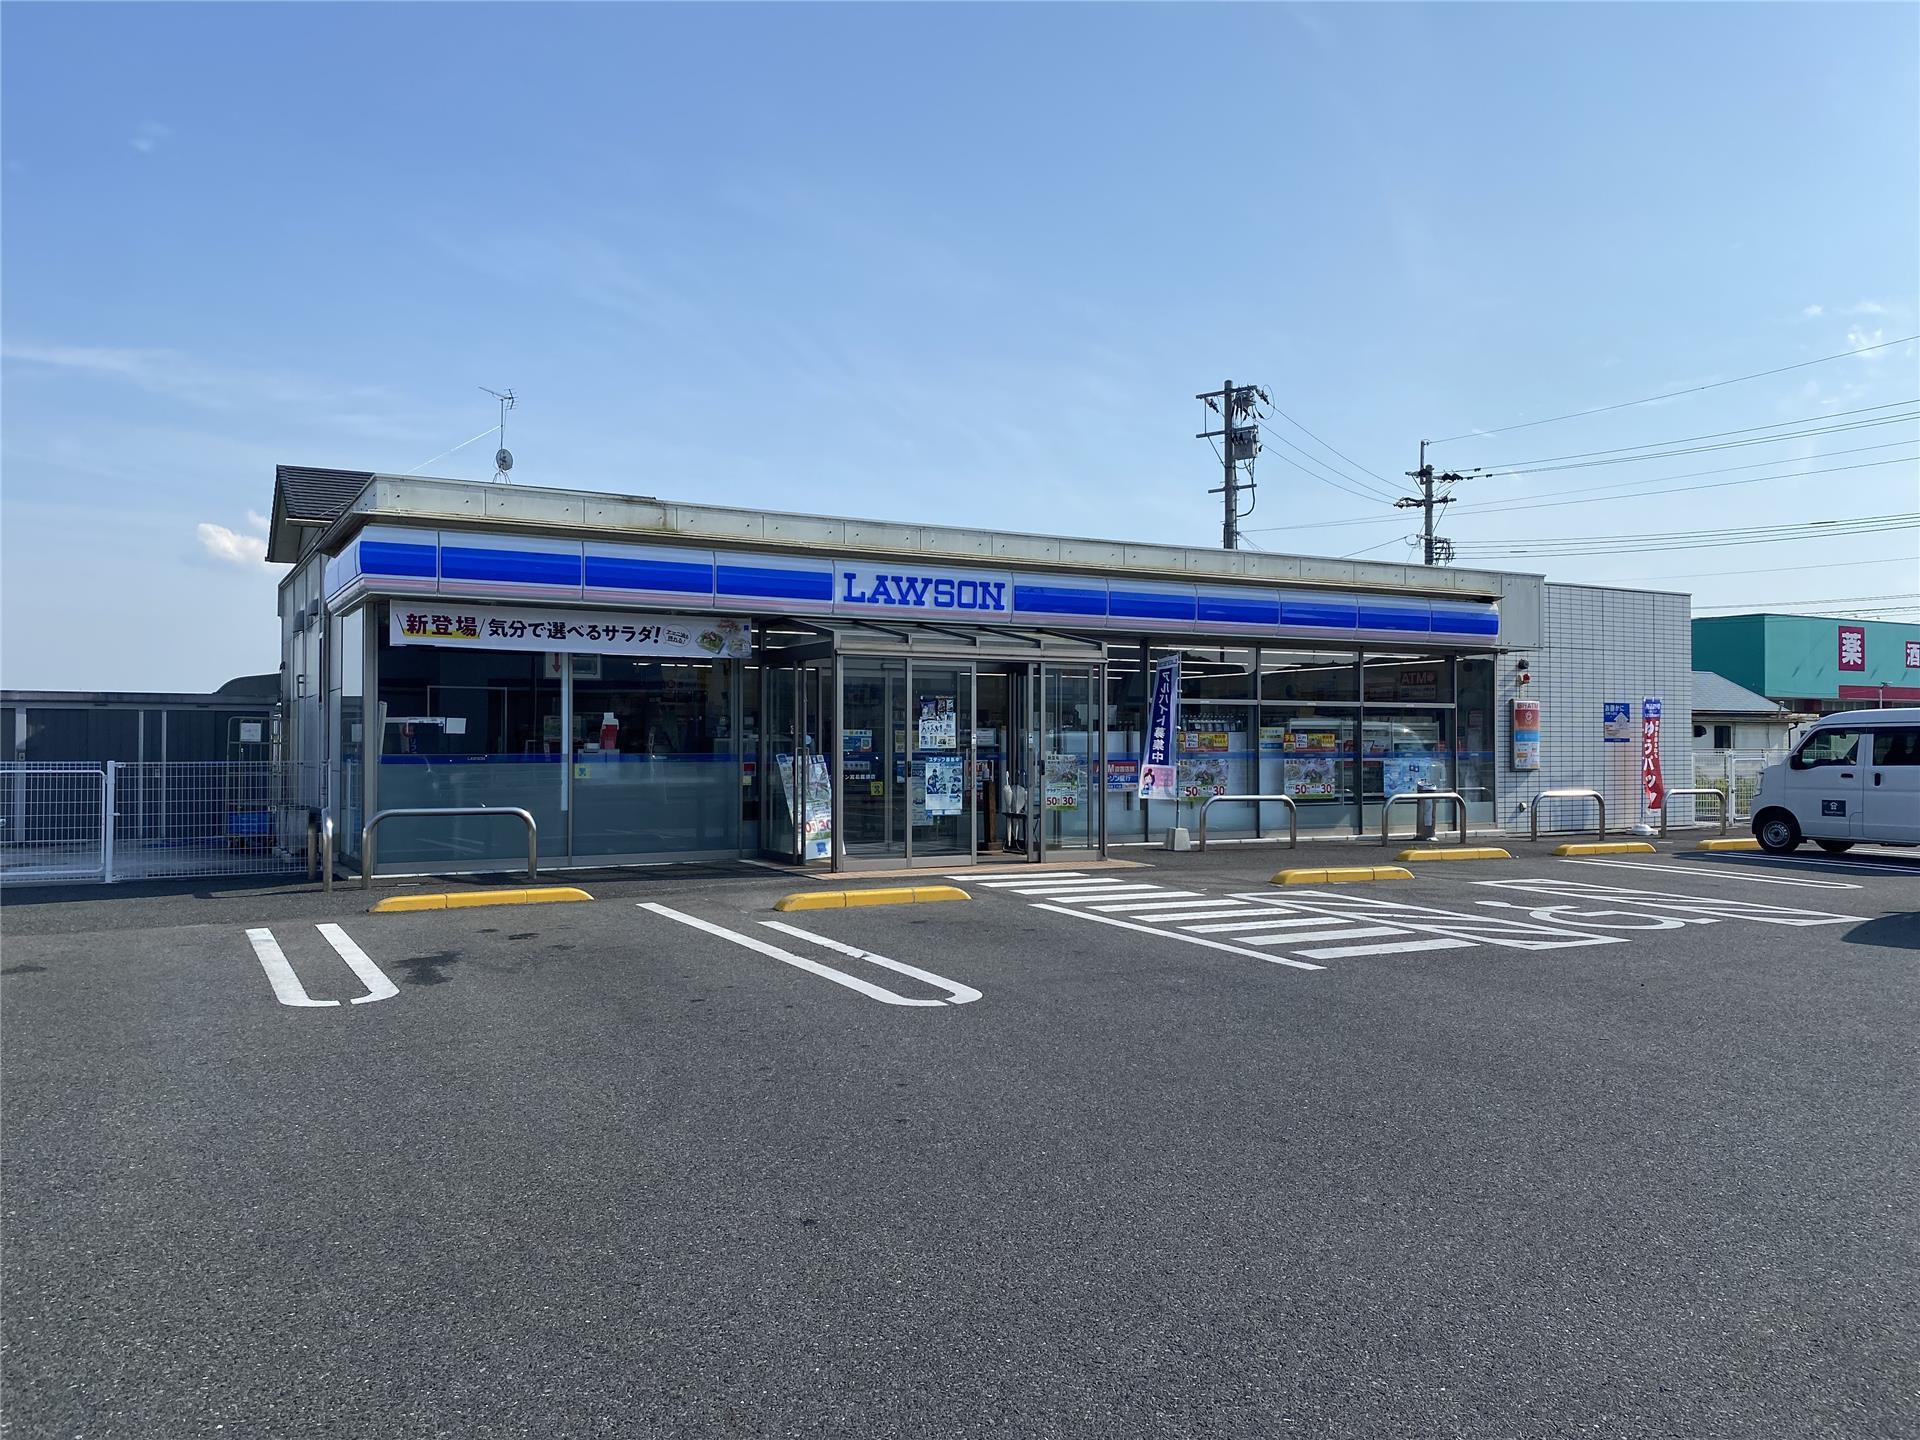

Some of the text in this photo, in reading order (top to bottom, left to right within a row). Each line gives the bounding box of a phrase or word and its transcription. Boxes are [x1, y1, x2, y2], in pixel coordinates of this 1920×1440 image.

[843, 572, 1006, 611] LAWSON
[406, 613, 662, 644] 新登場 気分で選べるサラダ!
[1841, 632, 1862, 665] 薬
[1906, 643, 1920, 667] 酒
[1401, 671, 1427, 684] ATM
[1107, 775, 1131, 783] ソン銀行
